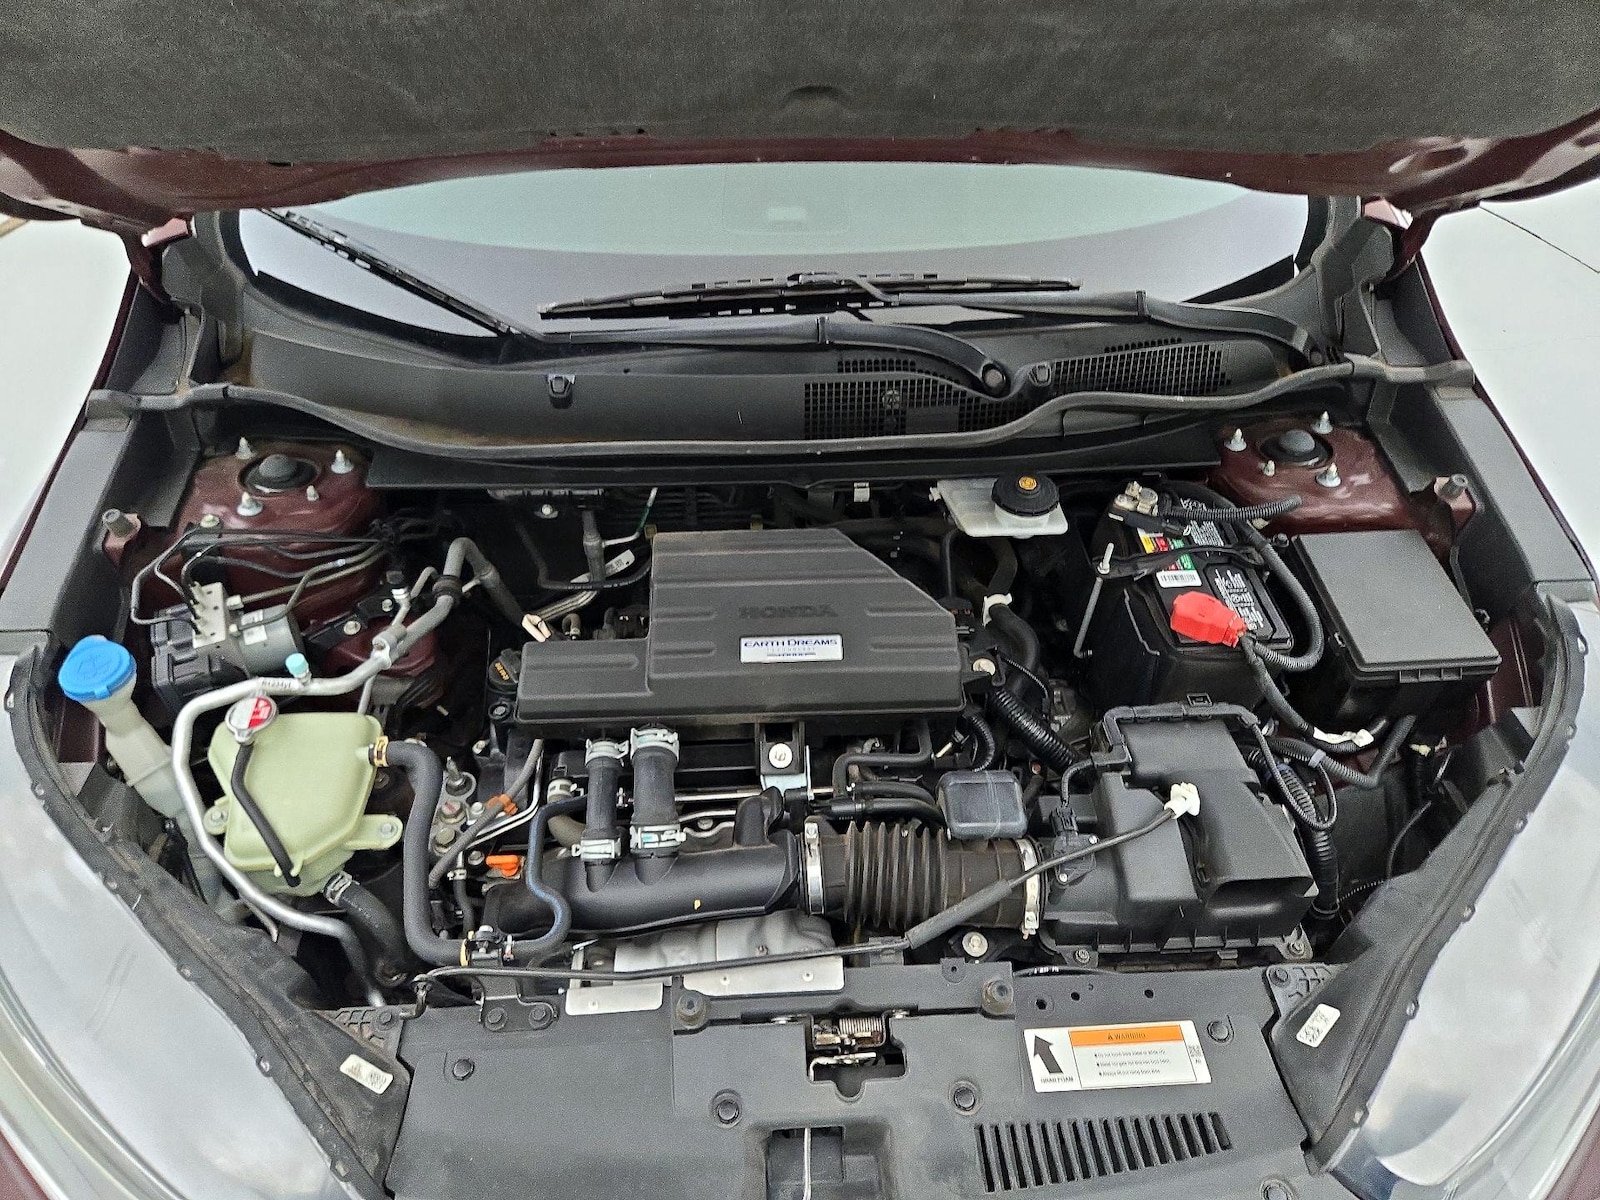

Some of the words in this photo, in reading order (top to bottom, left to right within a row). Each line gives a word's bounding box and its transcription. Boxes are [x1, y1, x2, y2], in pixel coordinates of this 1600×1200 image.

[739, 605, 838, 618] HONDA
[744, 639, 785, 648] EARTH
[787, 638, 838, 647] DREAMS
